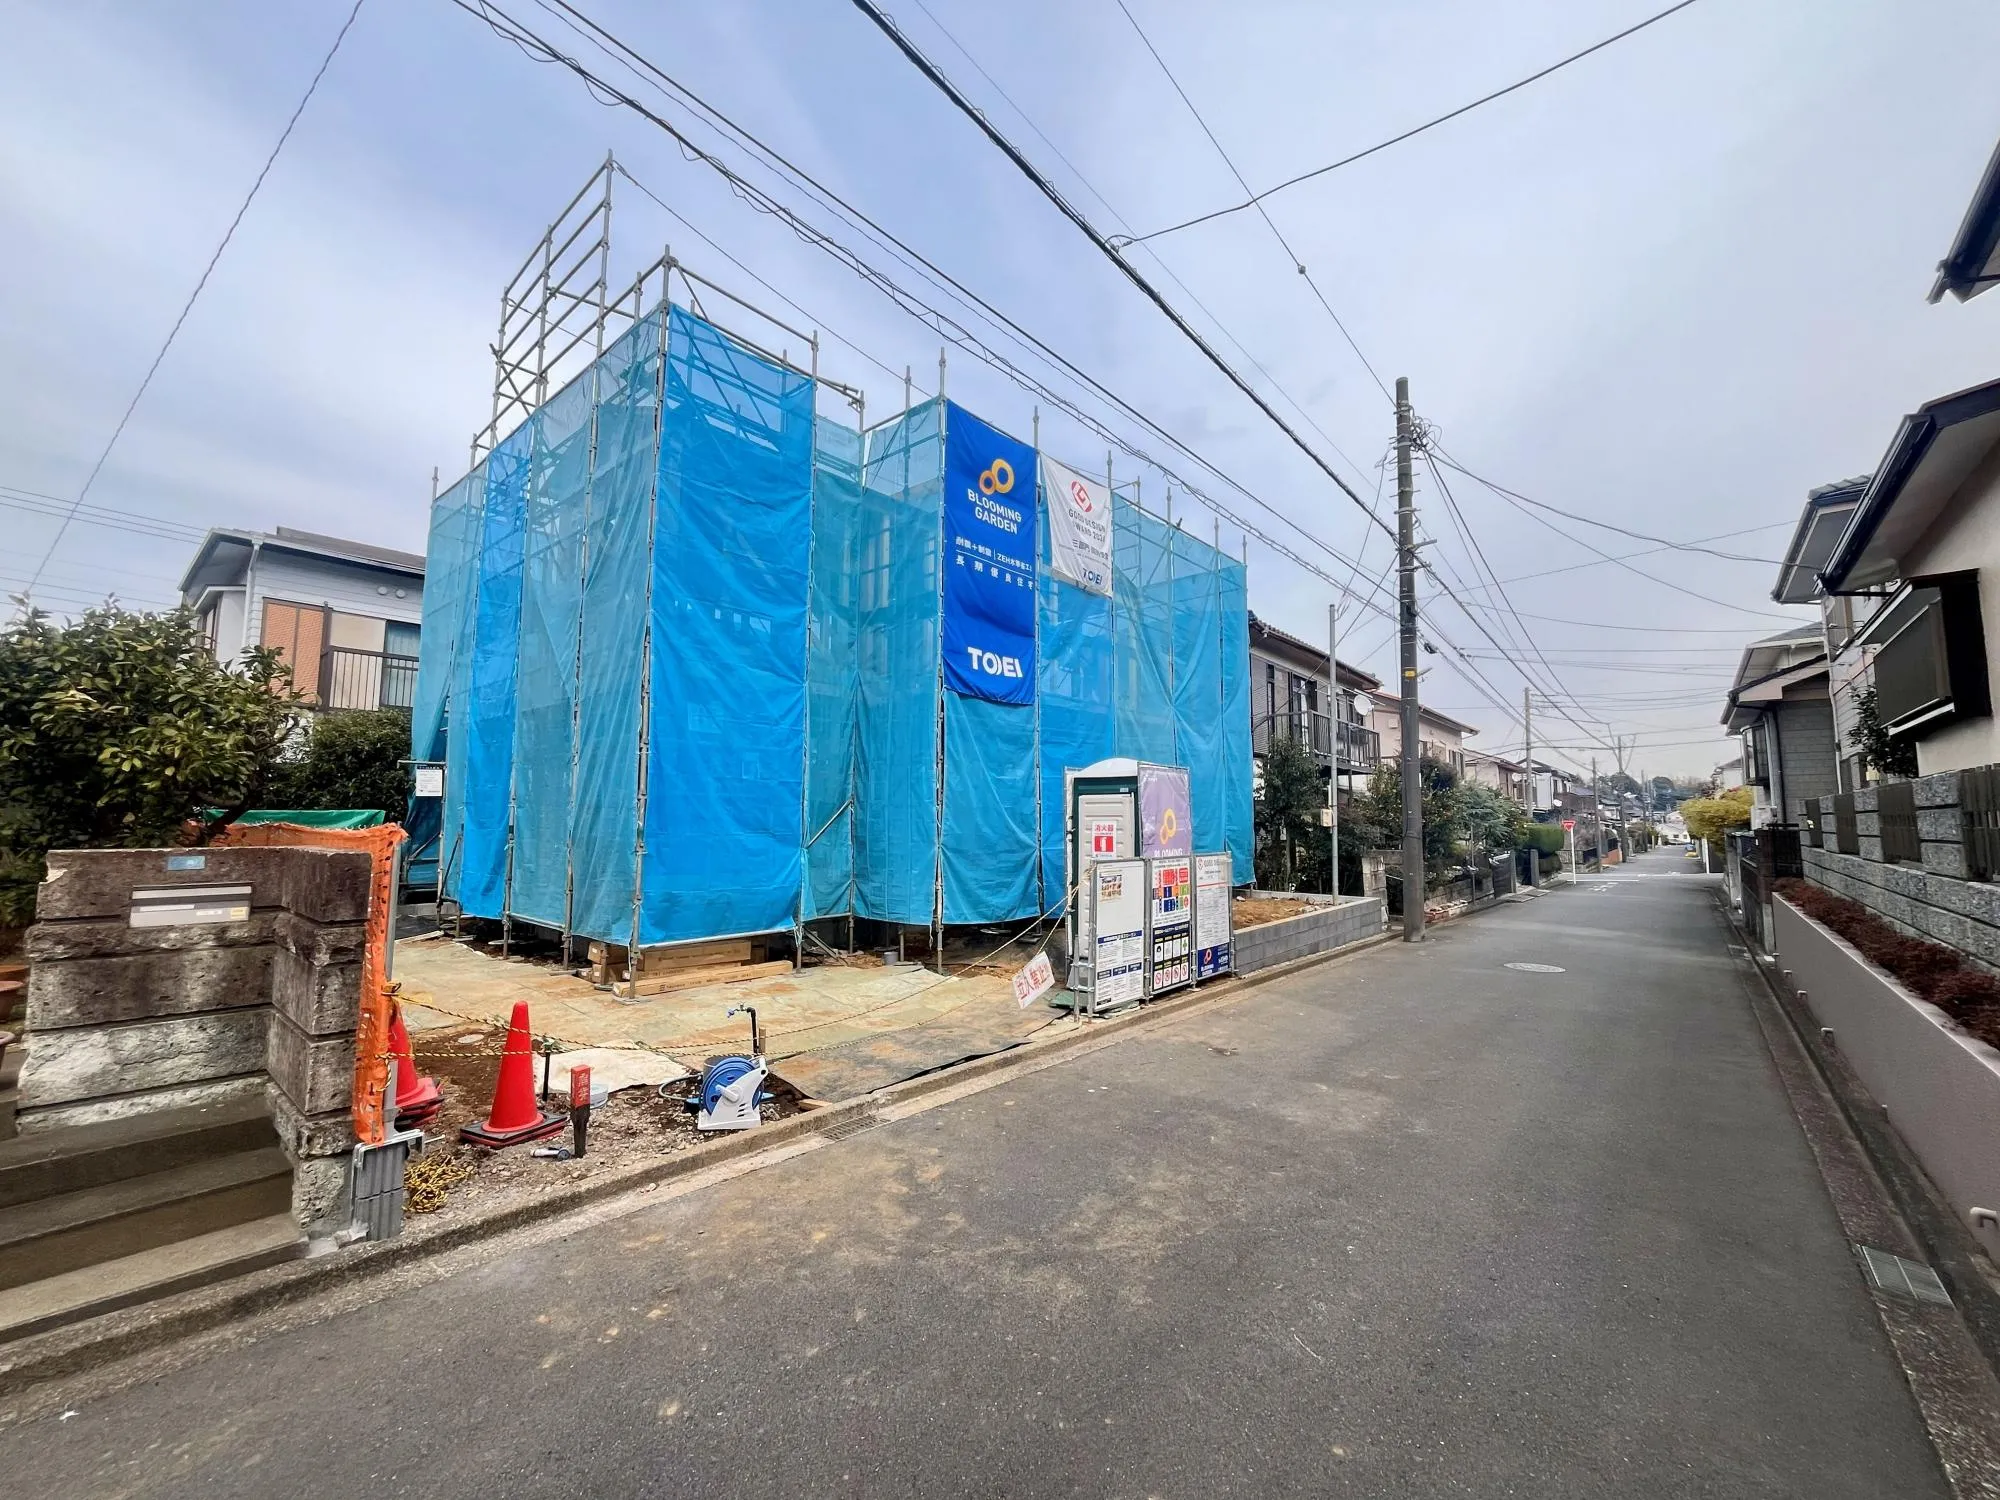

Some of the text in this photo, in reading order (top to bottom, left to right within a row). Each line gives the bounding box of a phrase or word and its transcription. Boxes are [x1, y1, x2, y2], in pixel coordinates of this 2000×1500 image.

[968, 488, 1022, 522] BLOOMING
[975, 507, 1018, 534] GARDEN
[1083, 567, 1103, 585] TOEI
[967, 646, 1023, 678] TOEI
